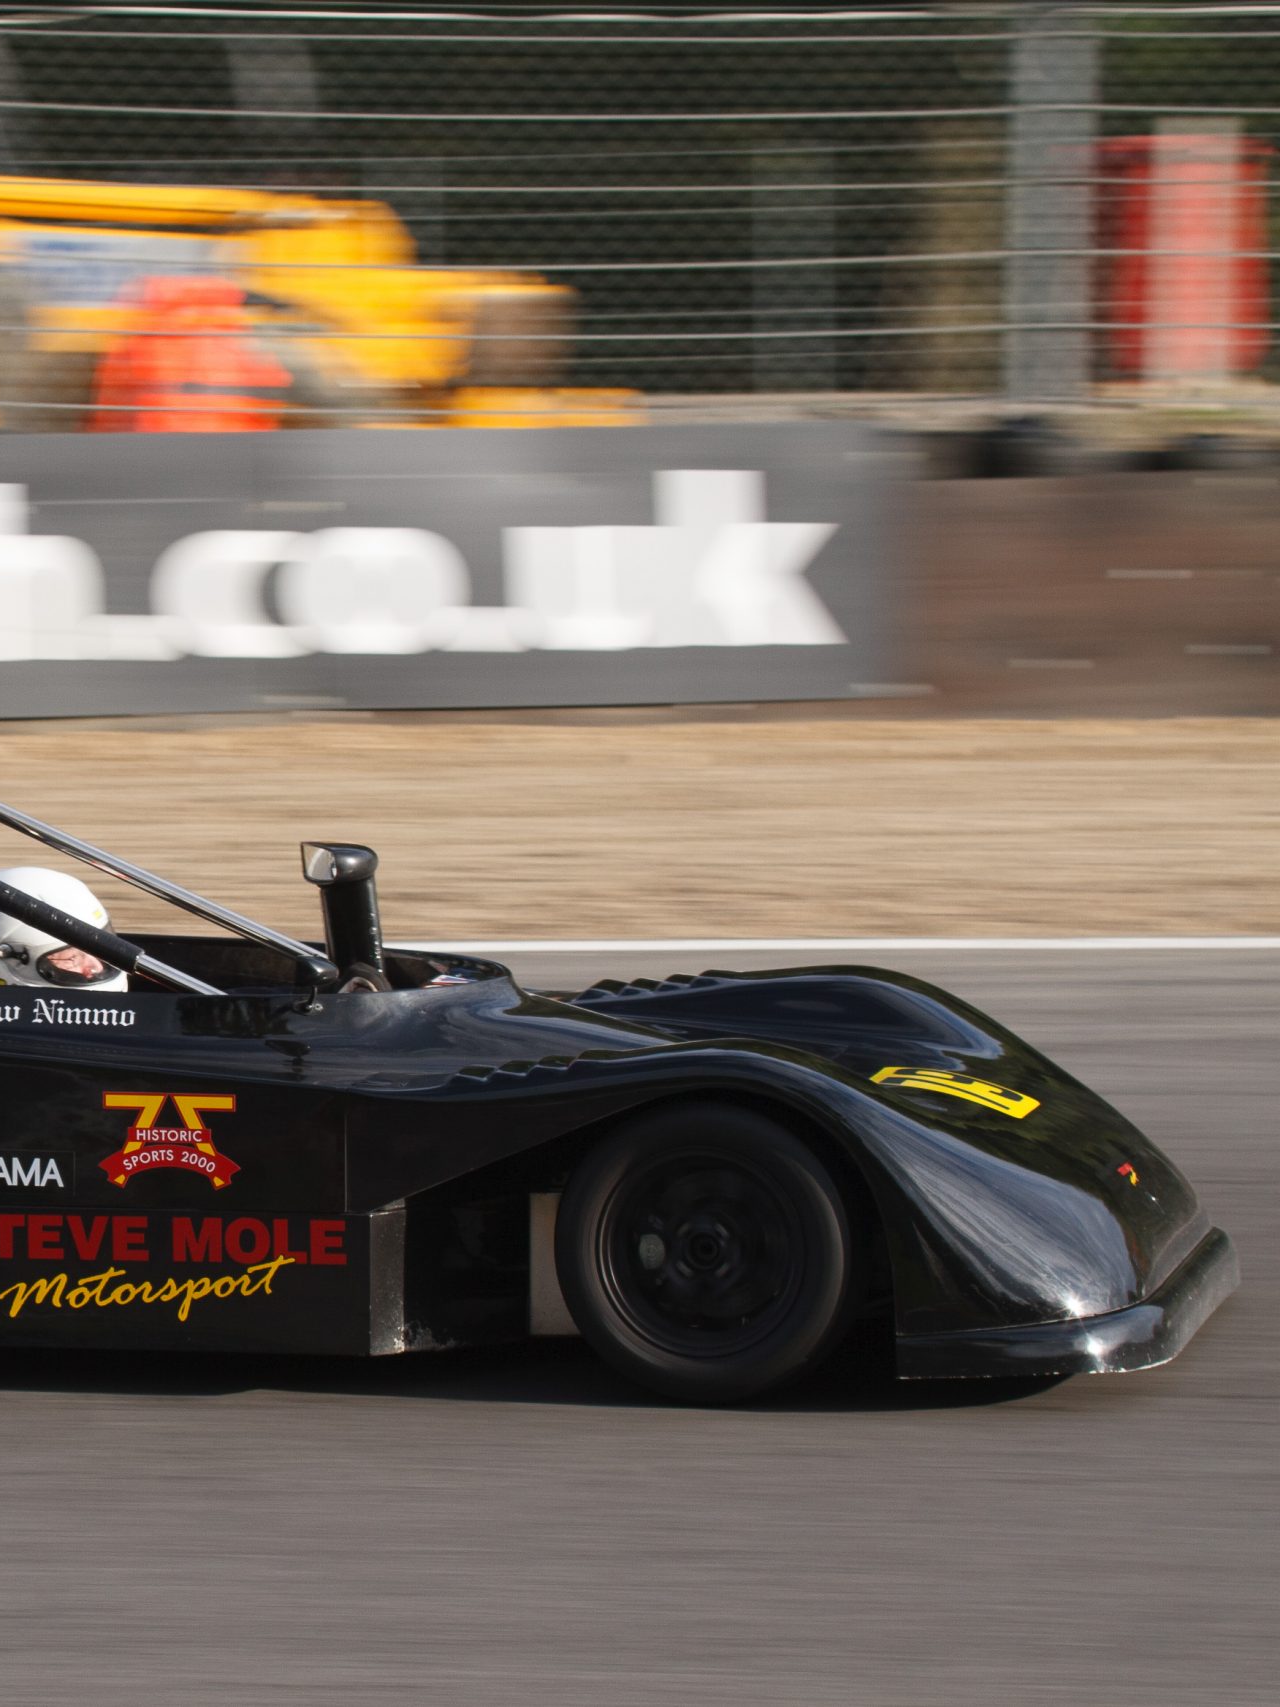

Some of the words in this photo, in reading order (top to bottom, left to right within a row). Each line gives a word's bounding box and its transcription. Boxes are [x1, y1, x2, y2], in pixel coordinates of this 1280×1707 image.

[32, 997, 136, 1027] Nimmo
[136, 1129, 203, 1142] HISTORIC
[123, 1149, 174, 1171] SPORTS
[181, 1151, 216, 1173] 2000
[172, 1216, 348, 1266] MOLE
[0, 1254, 296, 1322] Motorsport
